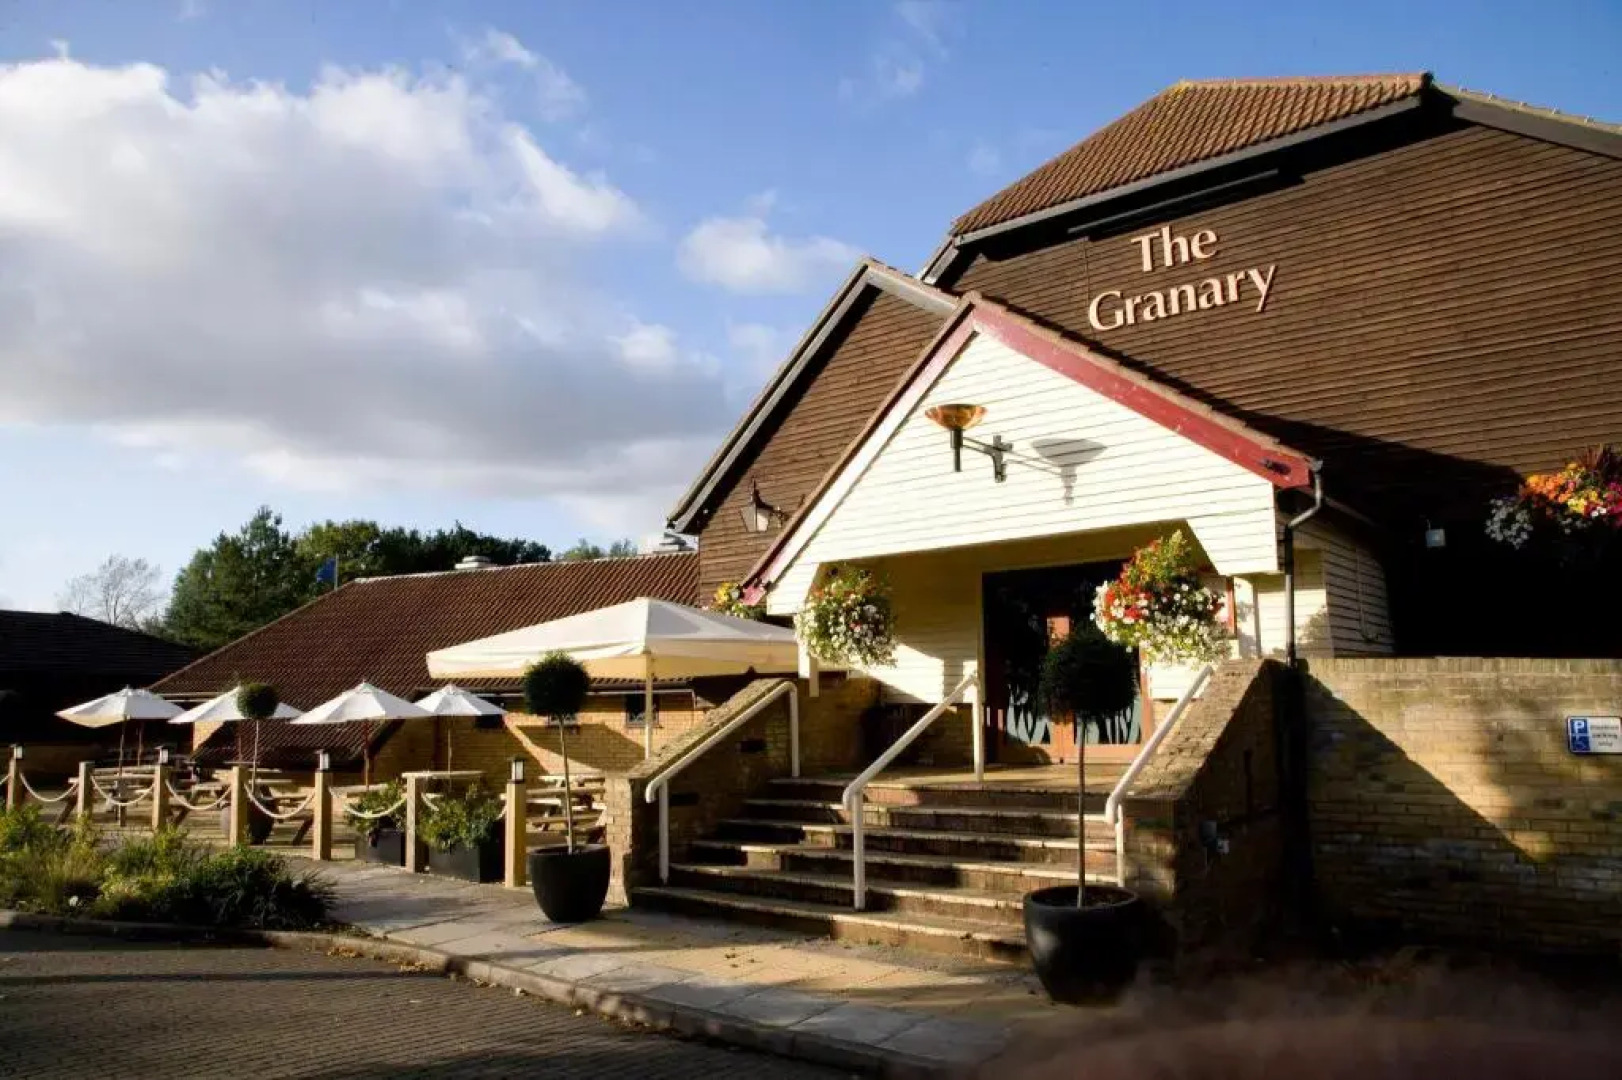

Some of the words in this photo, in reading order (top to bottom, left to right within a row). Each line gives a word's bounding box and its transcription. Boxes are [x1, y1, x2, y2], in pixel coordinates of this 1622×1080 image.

[1131, 226, 1218, 272] The
[1089, 264, 1276, 331] Granary
[1574, 720, 1584, 733] P
